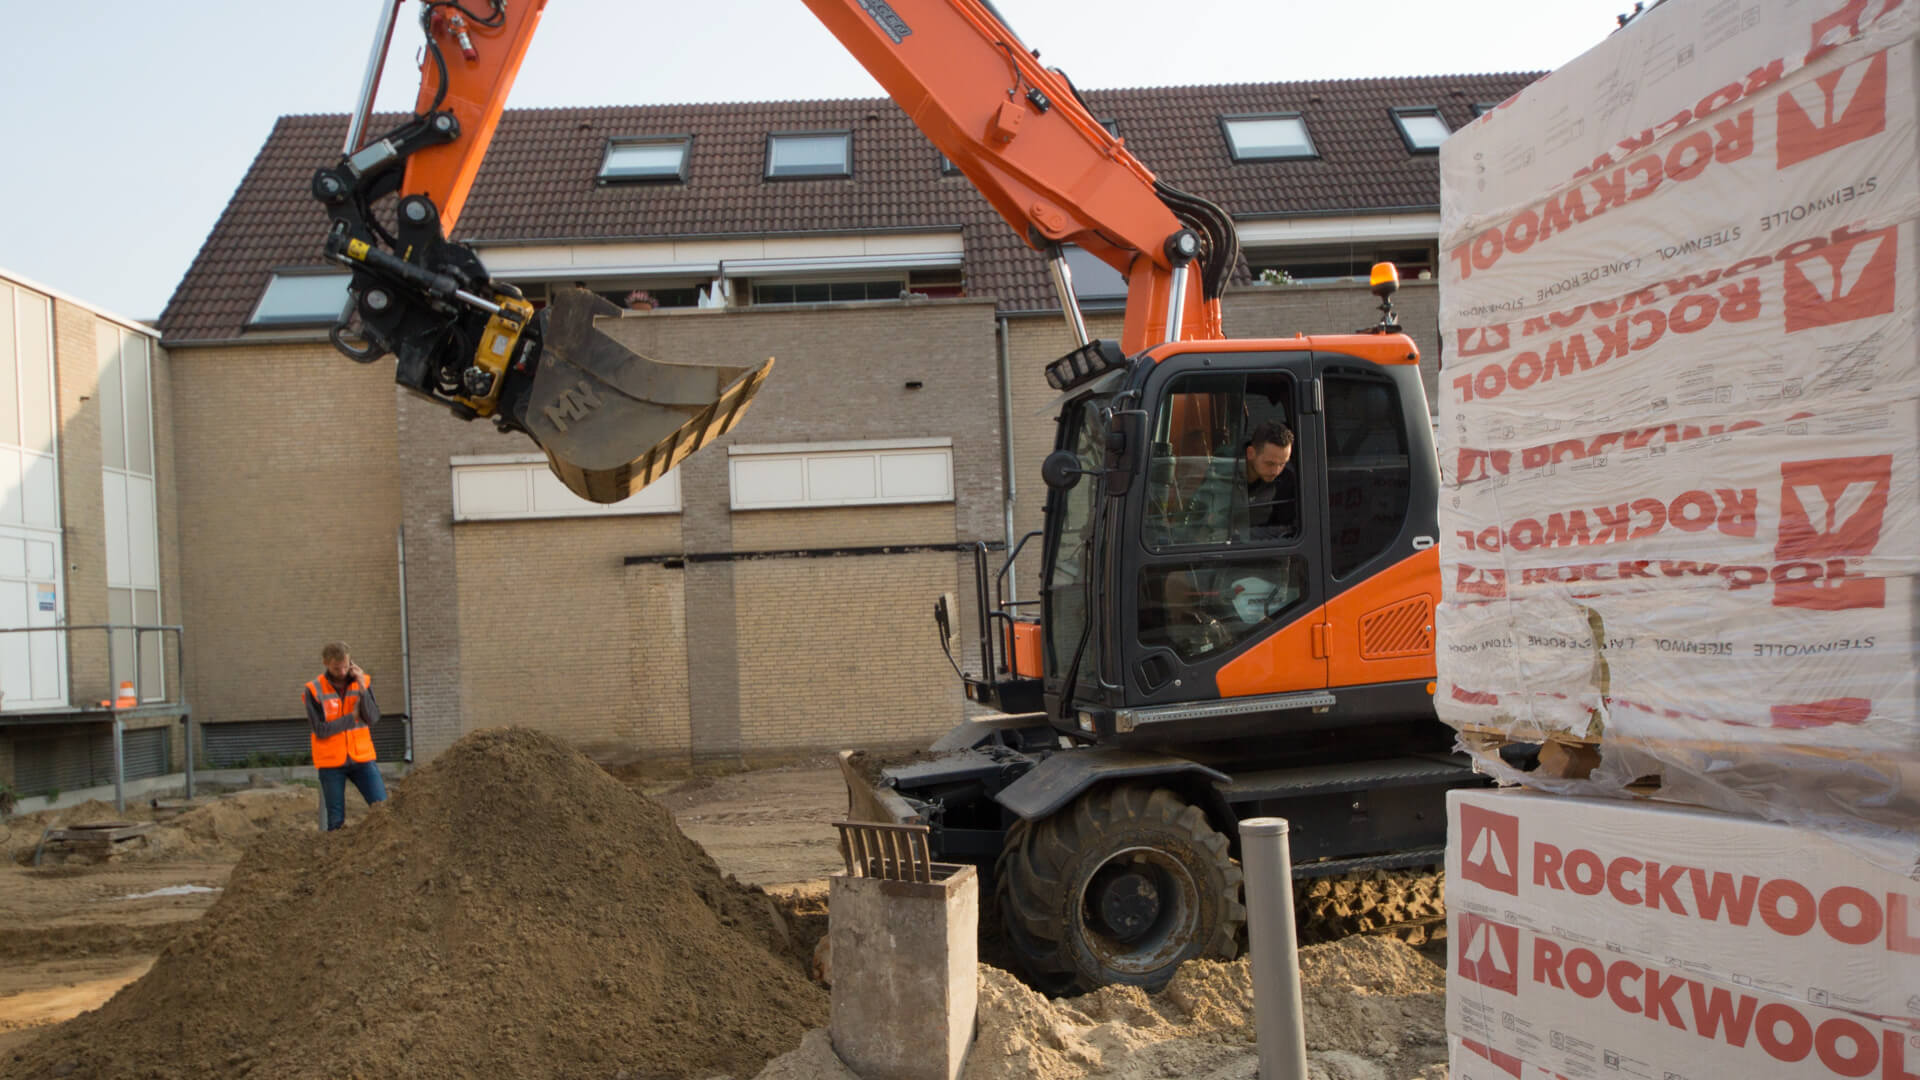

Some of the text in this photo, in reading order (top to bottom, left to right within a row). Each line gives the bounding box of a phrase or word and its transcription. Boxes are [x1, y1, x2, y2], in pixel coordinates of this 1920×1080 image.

[1451, 108, 1754, 281] ROCKWOOL
[1761, 176, 1877, 231] STEINWOLLE
[1656, 226, 1741, 261] STEENWOL
[1537, 275, 1579, 301] ROCHE
[1453, 276, 1761, 403] ROCKWOOL
[1456, 488, 1757, 552] ROCKWOOL
[1754, 636, 1875, 657] STEINWOLLE
[1533, 841, 1920, 954] ROCKWOOL
[1533, 937, 1920, 1080] ROCKWOOL
